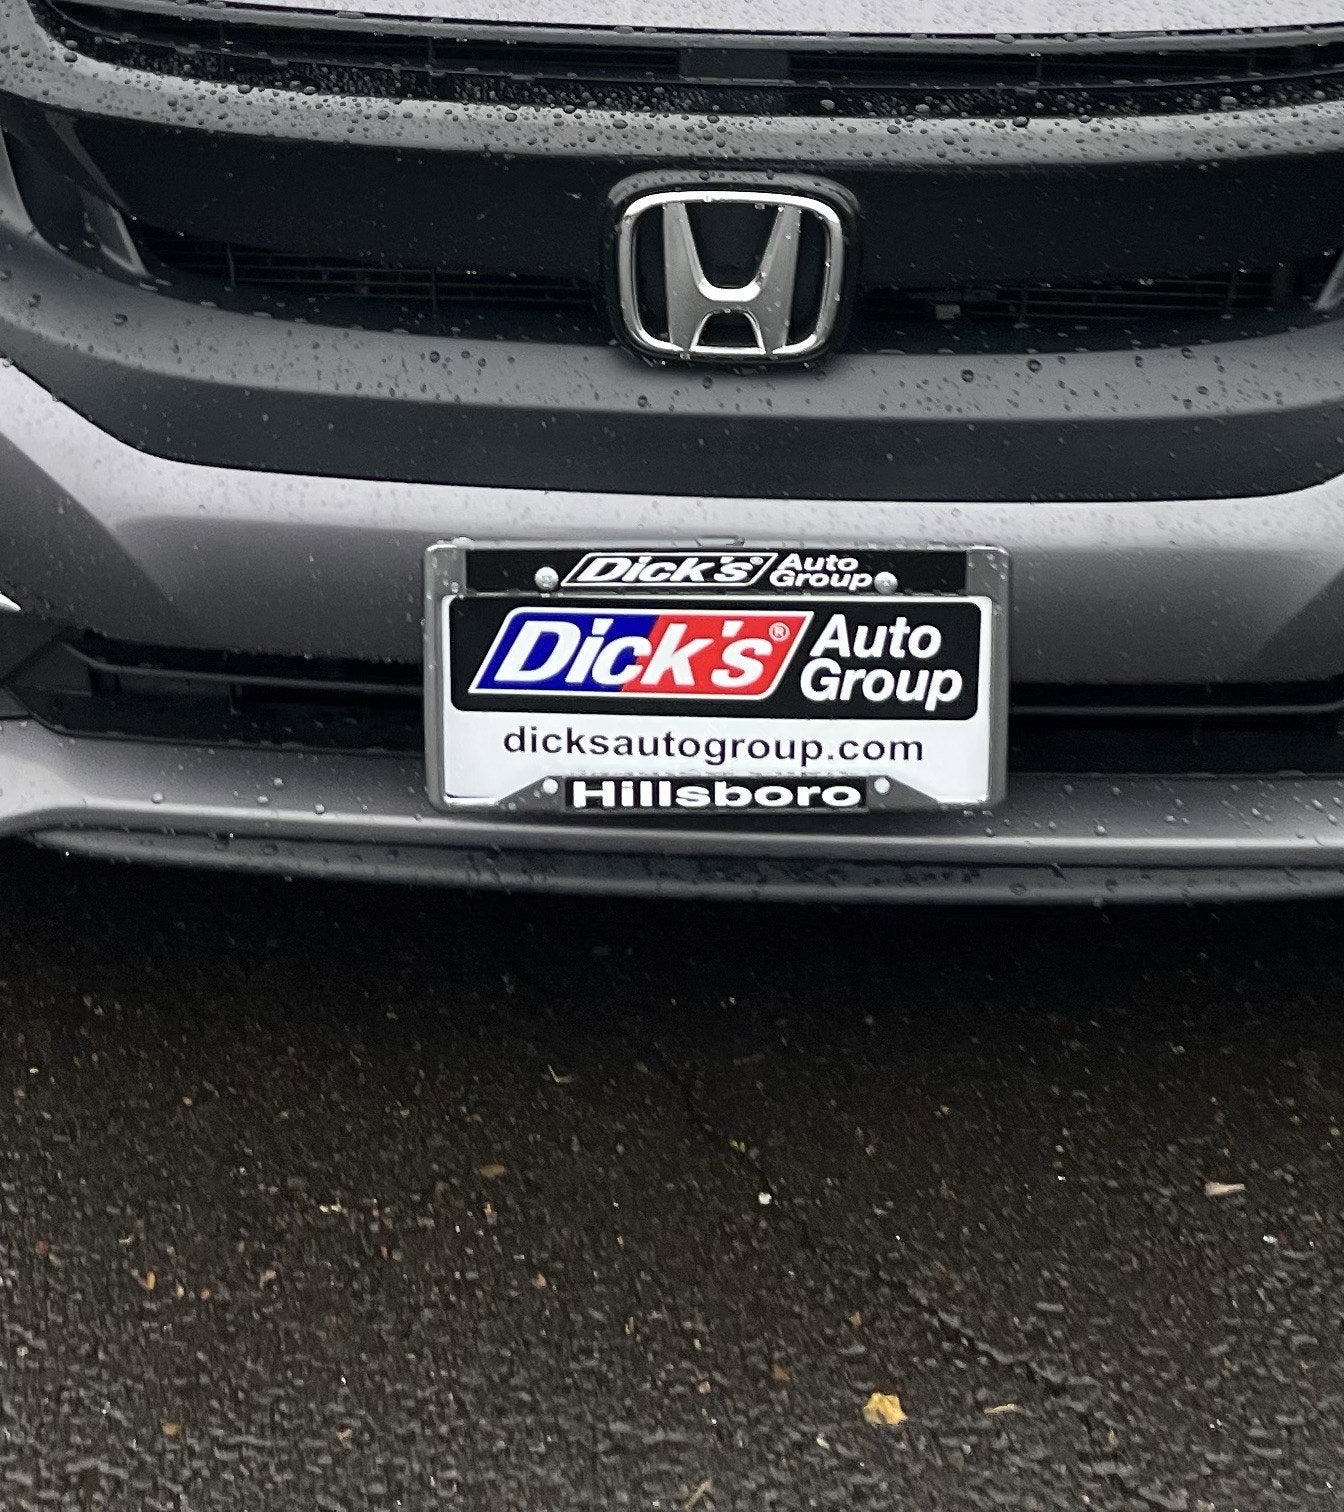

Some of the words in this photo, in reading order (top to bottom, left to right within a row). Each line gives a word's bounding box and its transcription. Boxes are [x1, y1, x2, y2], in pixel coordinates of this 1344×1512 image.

[769, 568, 873, 591] Group
[776, 553, 859, 572] Auto
[809, 613, 942, 658] Auto
[800, 656, 963, 711] Group
[503, 726, 924, 766] dicksautogroup.com
[572, 780, 862, 808] Hillsboro
